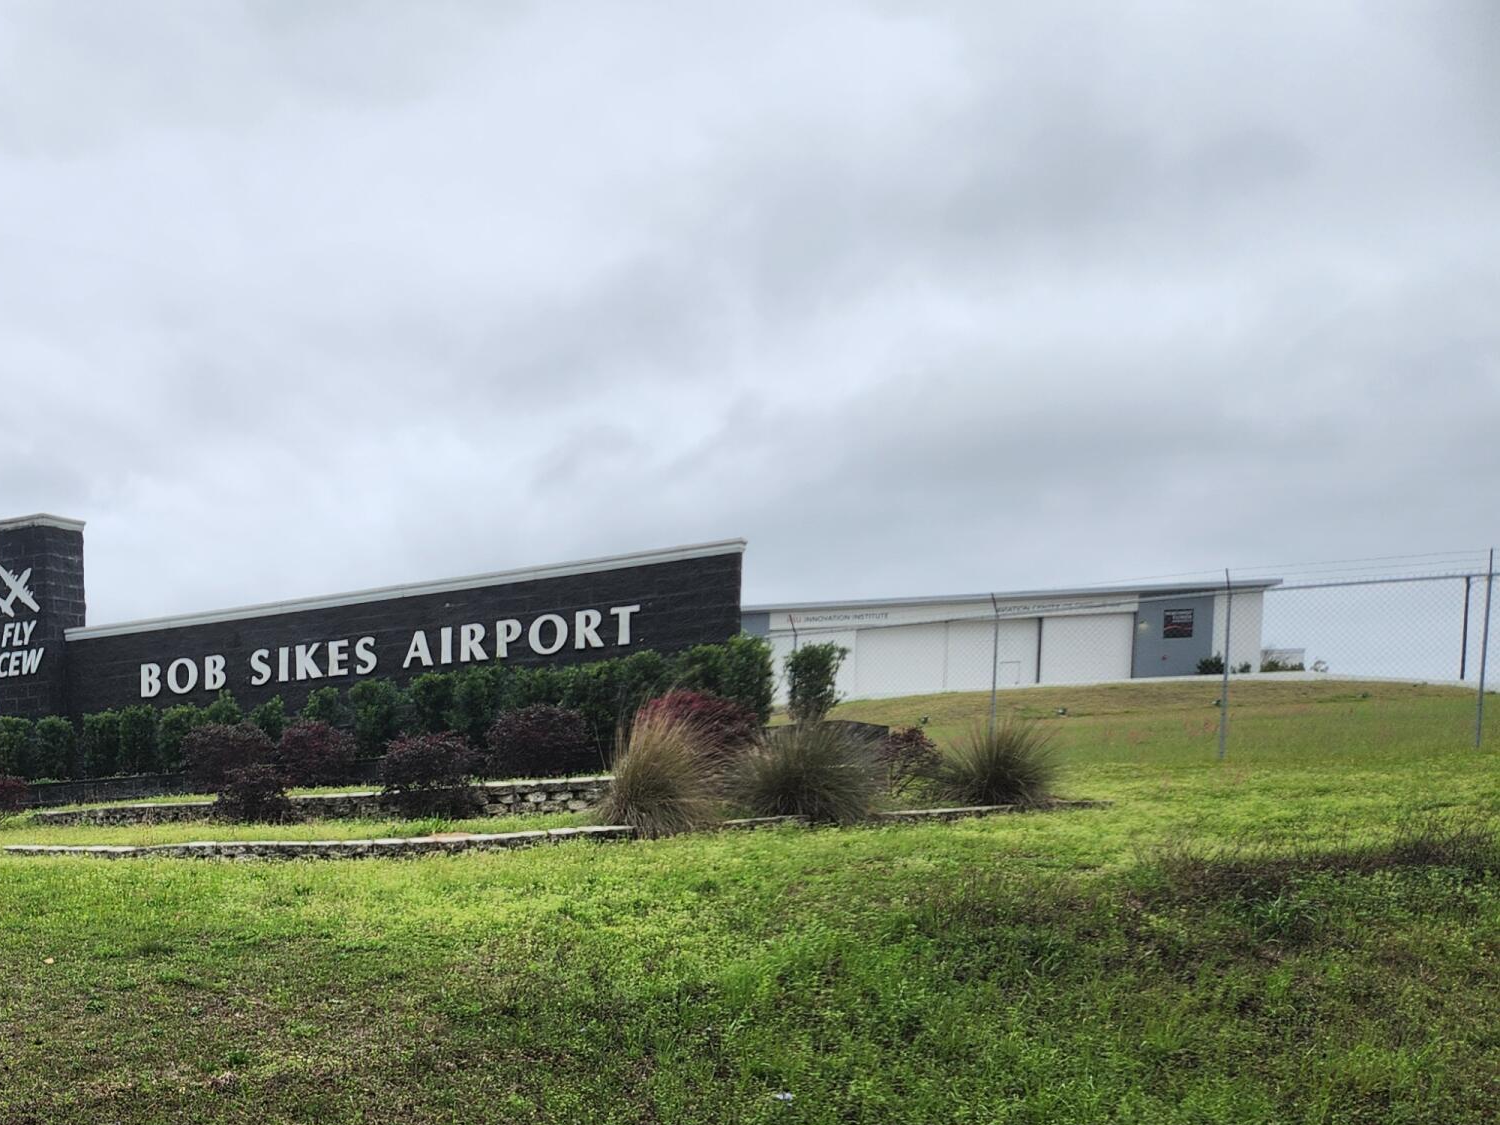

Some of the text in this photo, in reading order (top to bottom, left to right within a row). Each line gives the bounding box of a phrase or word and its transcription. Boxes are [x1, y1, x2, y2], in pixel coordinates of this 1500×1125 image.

[803, 615, 850, 623] INNOVATION
[852, 612, 889, 621] INSTITUTE
[1, 620, 37, 648] FLY
[140, 604, 641, 698] BOB SIKES AIRPORT
